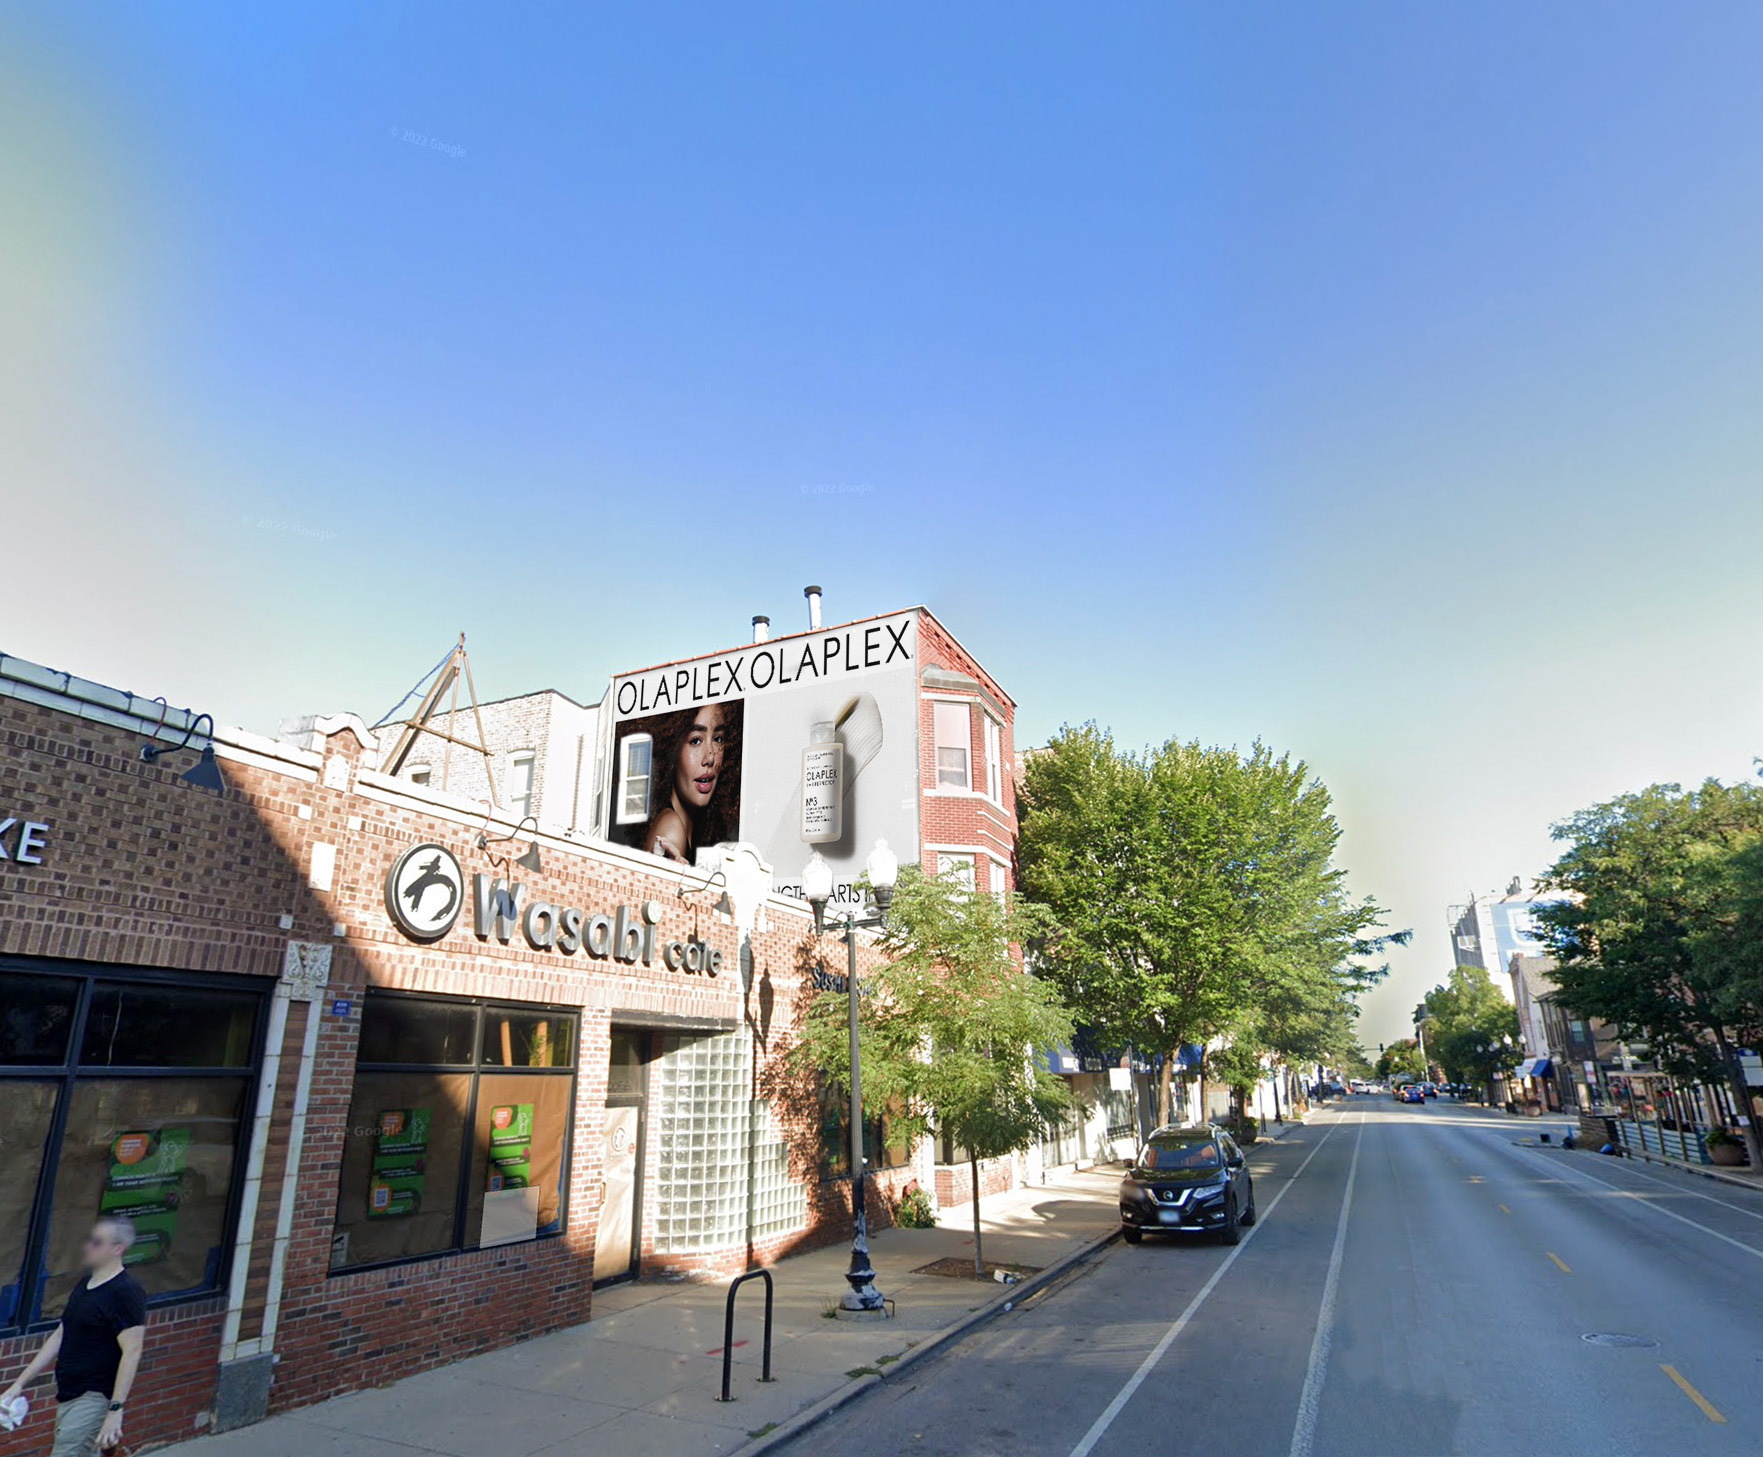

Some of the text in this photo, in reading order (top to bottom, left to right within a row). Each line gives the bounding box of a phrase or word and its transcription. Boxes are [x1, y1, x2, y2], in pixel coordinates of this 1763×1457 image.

[617, 656, 745, 715] OLAPLEX
[750, 620, 912, 689] OLAPLEX
[473, 873, 662, 967] Wasabi
